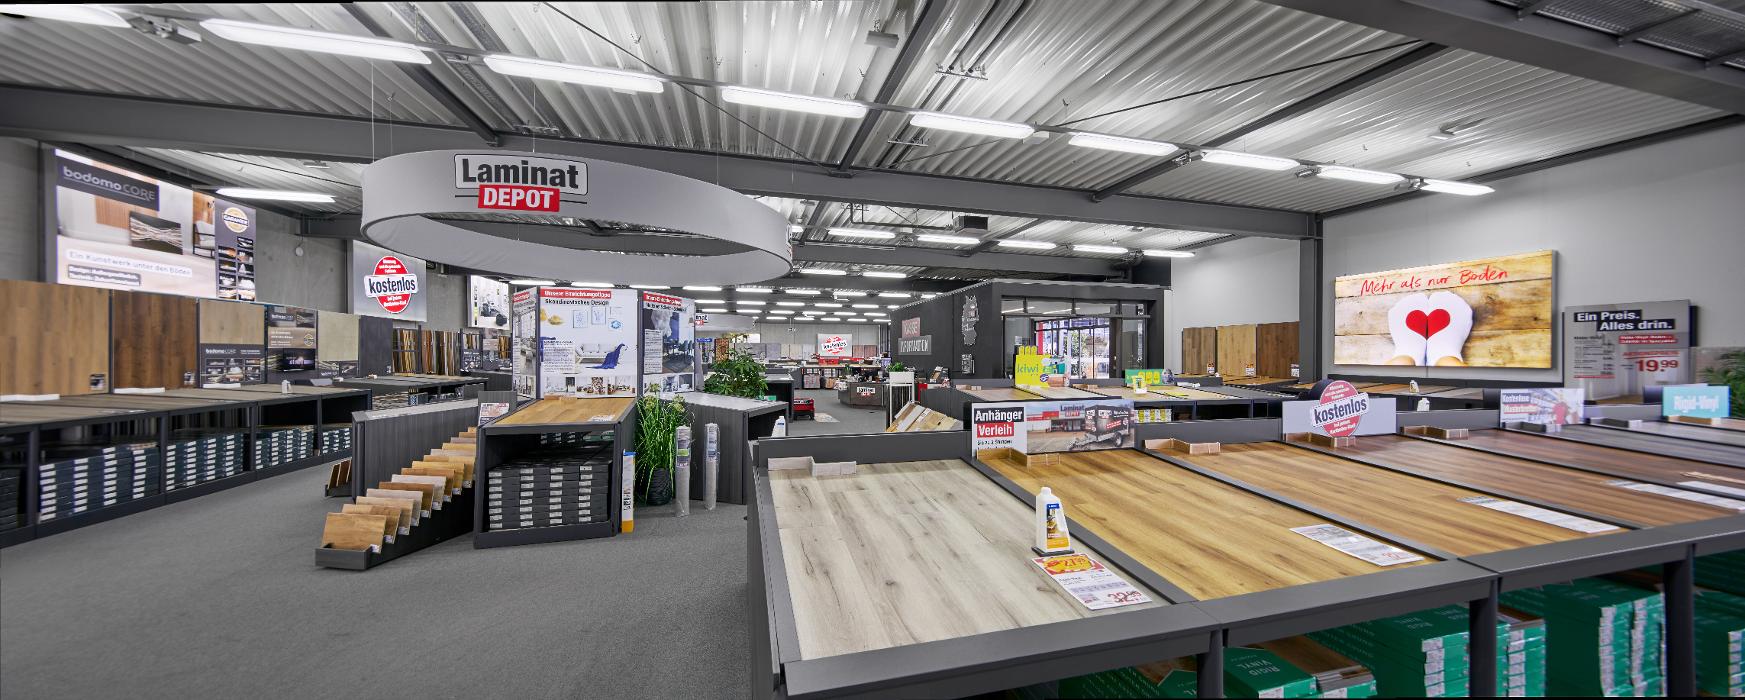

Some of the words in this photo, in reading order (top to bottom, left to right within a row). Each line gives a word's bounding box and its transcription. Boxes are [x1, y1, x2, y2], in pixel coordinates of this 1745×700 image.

[462, 158, 579, 189] Laminat
[483, 187, 554, 209] DEPOT
[368, 276, 416, 294] kostenlos
[1360, 278, 1395, 296] Mehr
[1400, 275, 1421, 289] als
[1428, 275, 1451, 287] nur
[1577, 312, 1597, 321] Ein
[1601, 311, 1640, 320] Preis.
[1600, 321, 1635, 331] Alles
[1638, 320, 1673, 330] drin.
[1017, 363, 1039, 373] kiwi
[1635, 359, 1679, 372] 19.99
[975, 409, 1023, 423] Anhänger
[1313, 398, 1368, 425] kostenlos
[978, 424, 1012, 436] Verleih
